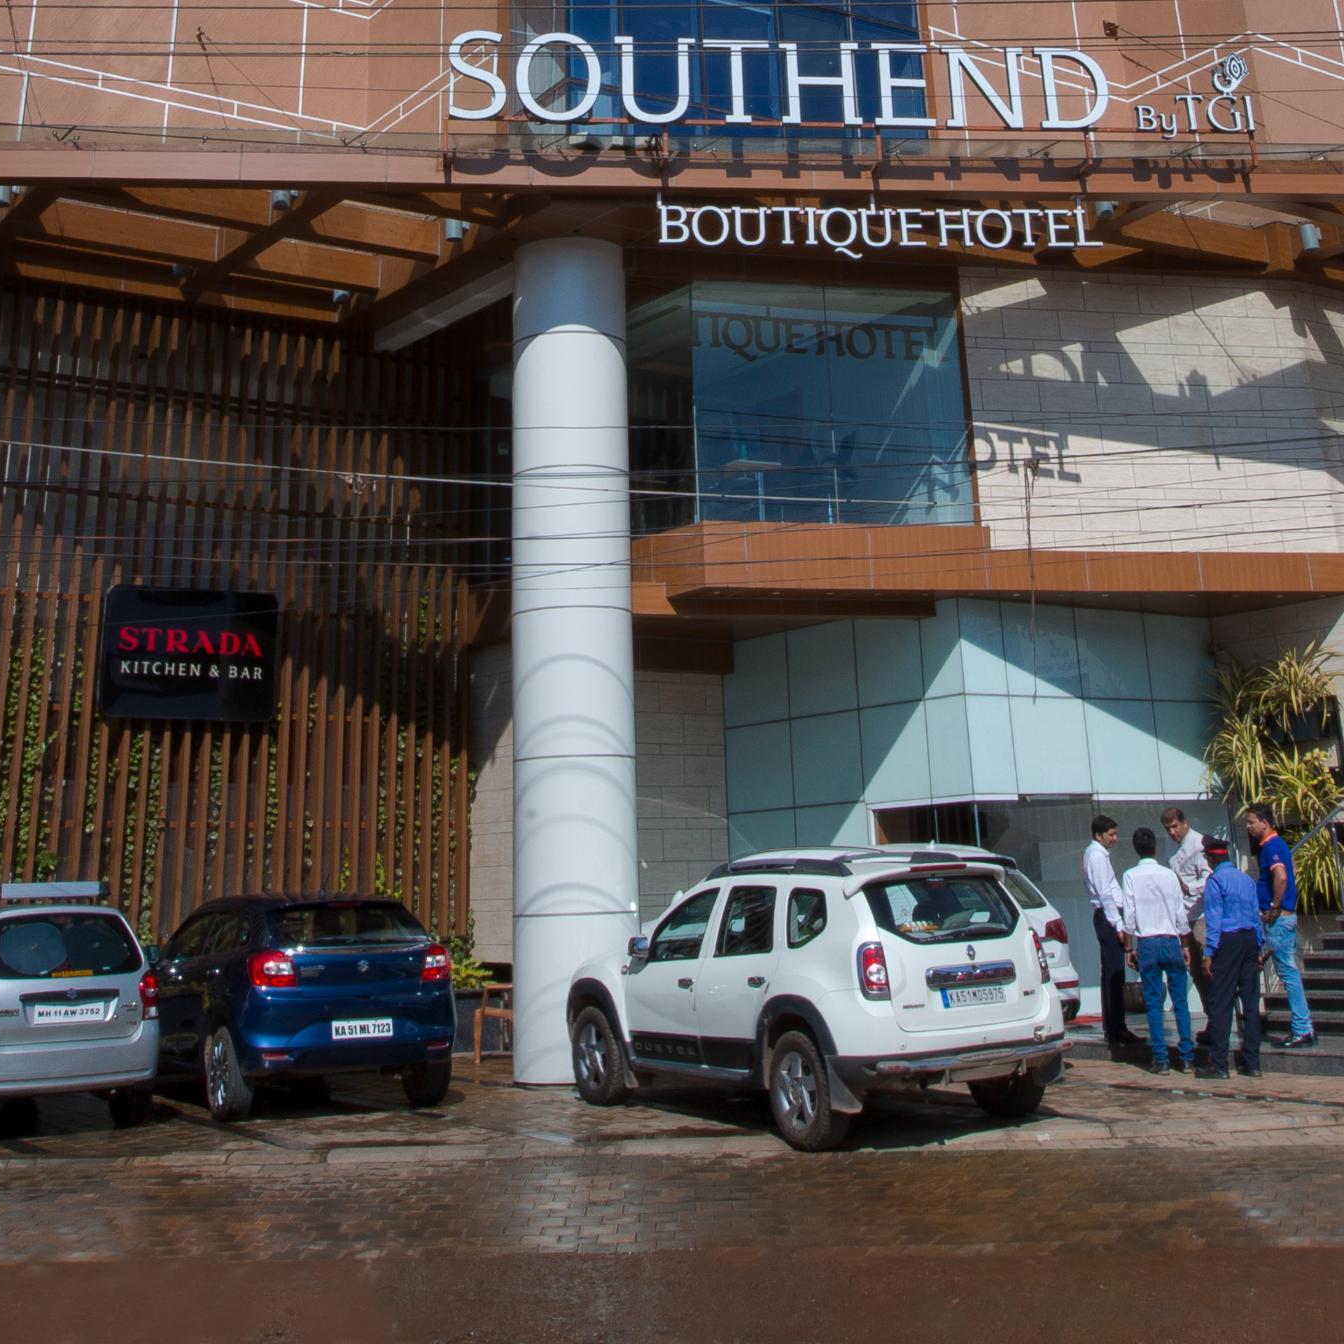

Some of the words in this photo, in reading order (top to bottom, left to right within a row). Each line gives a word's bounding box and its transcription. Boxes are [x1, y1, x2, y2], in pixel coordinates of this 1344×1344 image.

[448, 30, 1109, 130] SOUTHEND
[1135, 104, 1177, 139] By
[1175, 94, 1256, 133] TGI
[659, 204, 923, 258] BOUTIQUE
[938, 207, 1103, 248] HOTEL
[117, 625, 263, 657] STRADA
[120, 660, 201, 677] KITCHEN
[208, 664, 220, 678] &
[228, 665, 263, 680] BAR
[37, 1009, 52, 1018] MH
[63, 1008, 78, 1017] AW
[79, 1007, 101, 1016] 3752
[334, 1025, 347, 1036] KA
[348, 1025, 358, 1036] 51
[359, 1024, 371, 1034] ML
[372, 1022, 391, 1034] 7123
